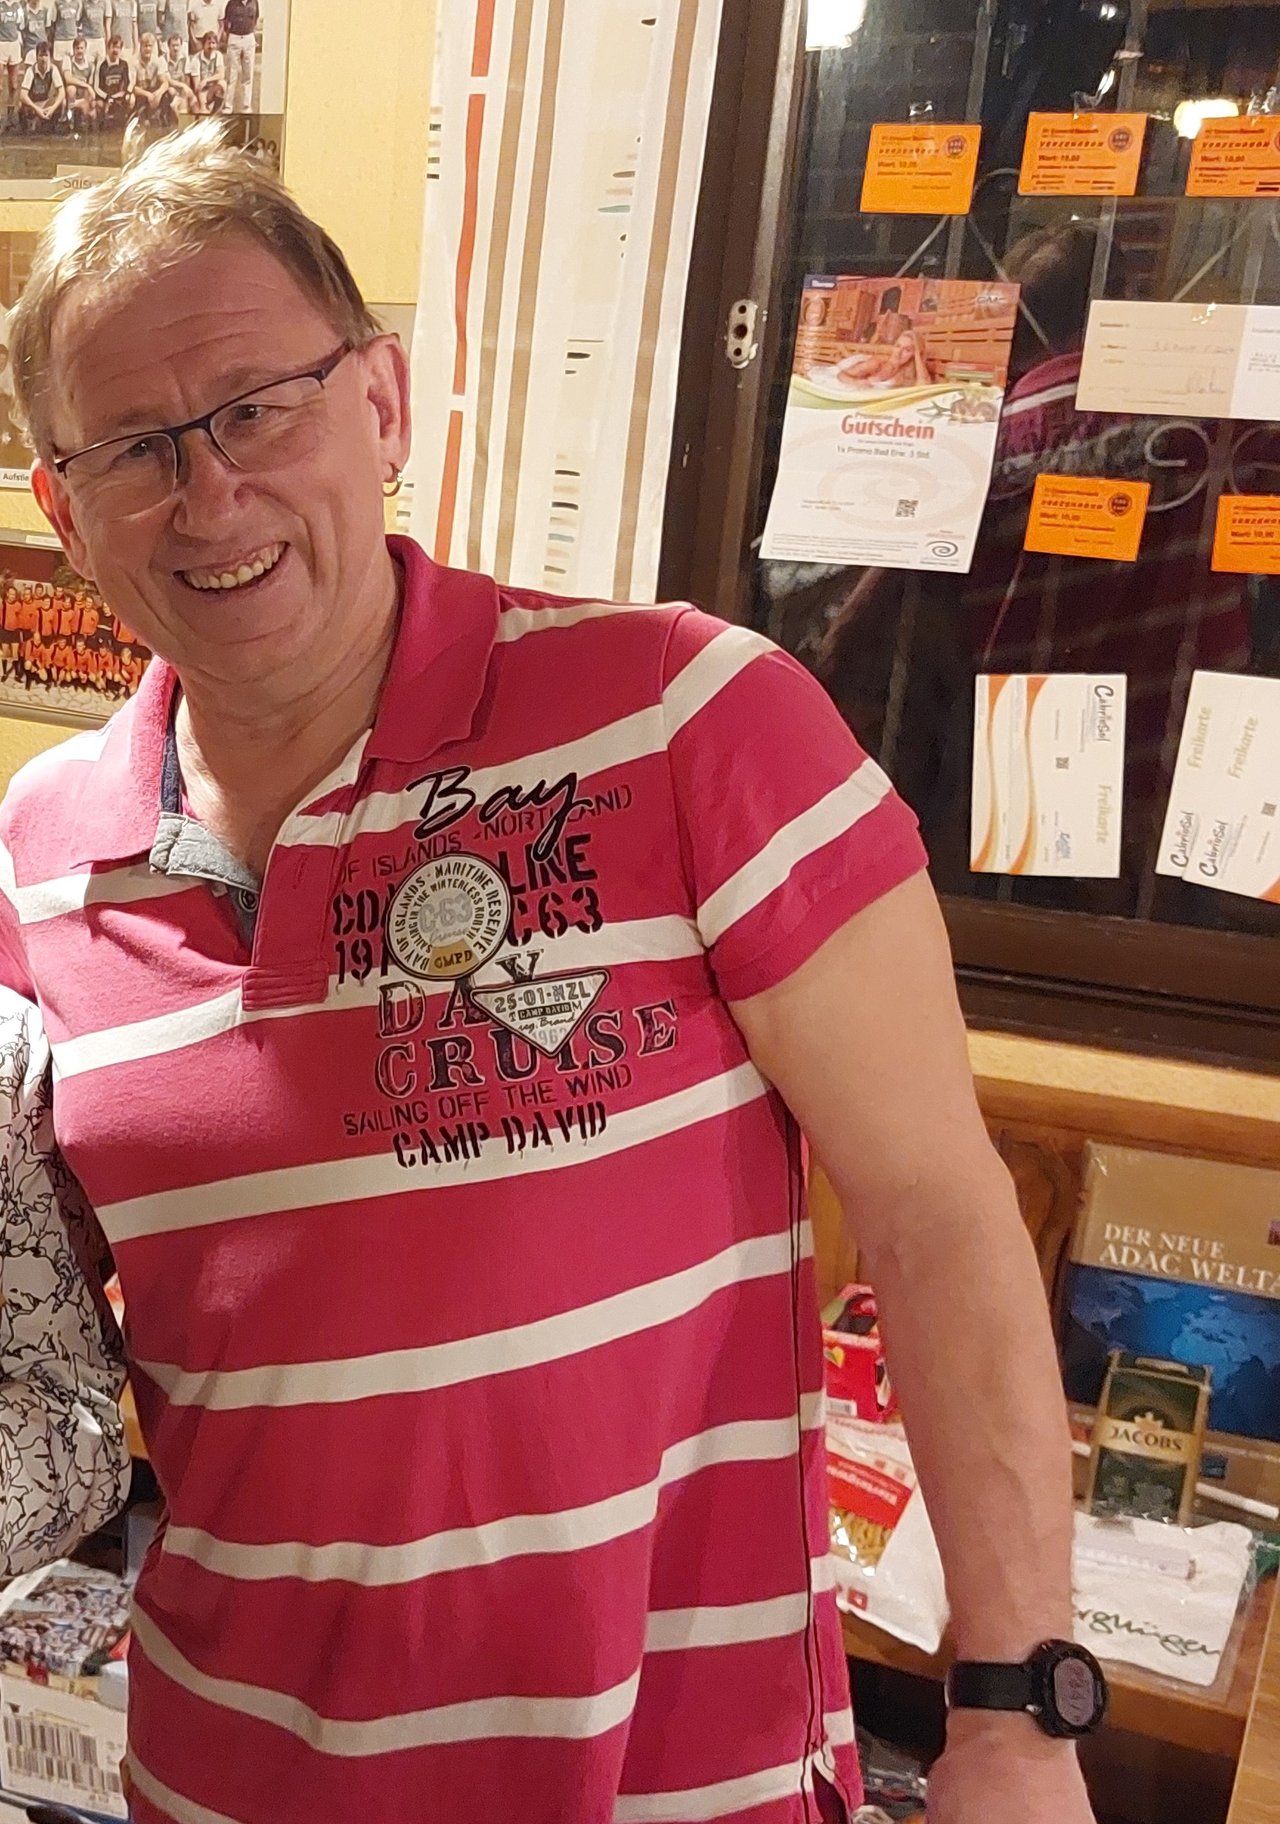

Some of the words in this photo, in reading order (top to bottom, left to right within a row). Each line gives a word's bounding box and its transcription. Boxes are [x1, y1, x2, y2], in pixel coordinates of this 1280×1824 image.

[841, 414, 935, 440] Gutschein
[3, 472, 29, 482] Aufstie
[1228, 715, 1259, 779] Freikarte
[406, 766, 593, 863] Bay
[372, 830, 462, 878] ISLANDS
[429, 878, 483, 905] WINTERLESS
[434, 861, 495, 890] MARITIME
[394, 876, 426, 933] ISLANDS
[413, 889, 430, 908] THE
[409, 911, 419, 921] IN
[466, 906, 485, 940] NORTH
[473, 889, 502, 955] RESERVE
[396, 936, 410, 953] OF
[408, 921, 433, 954] SAILING
[404, 949, 430, 972] BAY
[520, 1007, 544, 1019] CAMP
[545, 1002, 571, 1015] DAVID
[375, 999, 681, 1099] CRUISE
[343, 1101, 429, 1136] SAILING
[438, 1091, 490, 1120] OFF
[502, 1080, 554, 1109] THE
[565, 1064, 633, 1099] WIND
[391, 1122, 490, 1169] CAMP
[501, 1101, 608, 1155] DAVID
[1104, 1222, 1152, 1248] DER
[1158, 1232, 1225, 1260] NEUE
[1098, 1243, 1183, 1276] ADAC
[1110, 1426, 1184, 1451] JACOBS
[1077, 1609, 1221, 1657] rgnügen
